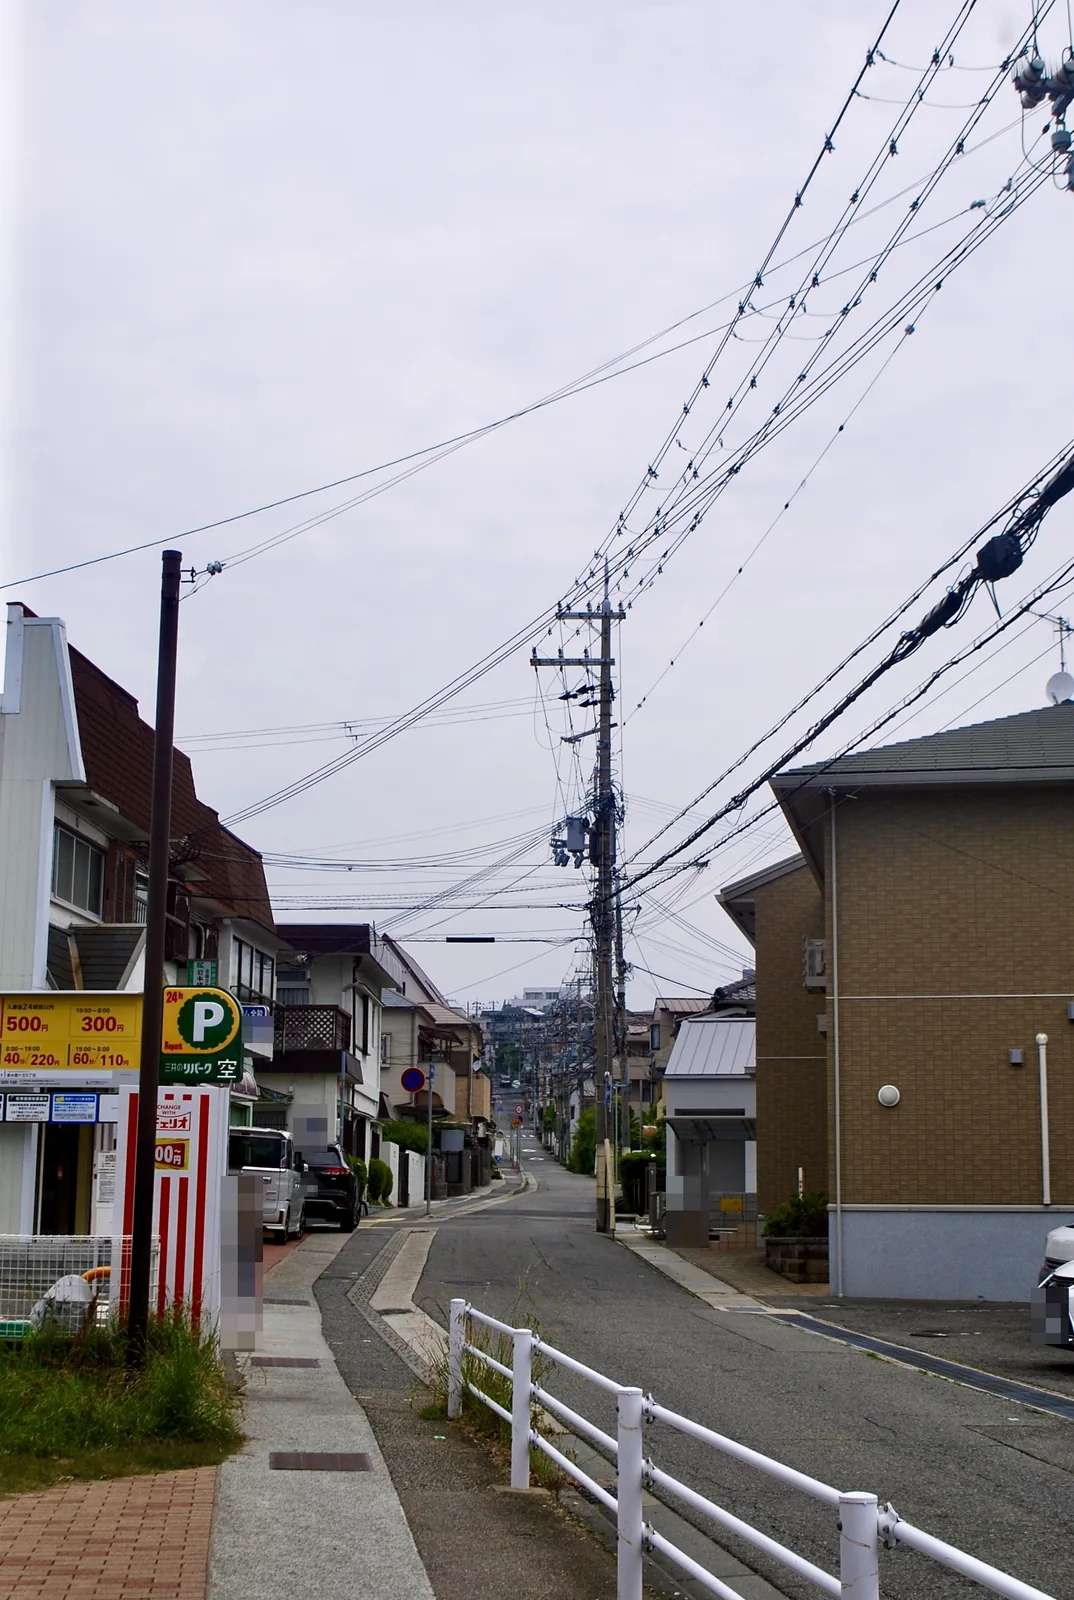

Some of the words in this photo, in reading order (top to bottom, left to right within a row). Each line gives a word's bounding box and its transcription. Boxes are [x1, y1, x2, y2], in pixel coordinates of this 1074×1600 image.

[166, 991, 183, 1003] 24h
[7, 1016, 49, 1032] 500円
[81, 1016, 124, 1032] 300円
[193, 1001, 225, 1042] P
[164, 1041, 183, 1051] Repark
[165, 1062, 212, 1075] 三井のリパーク
[217, 1059, 237, 1078] 空
